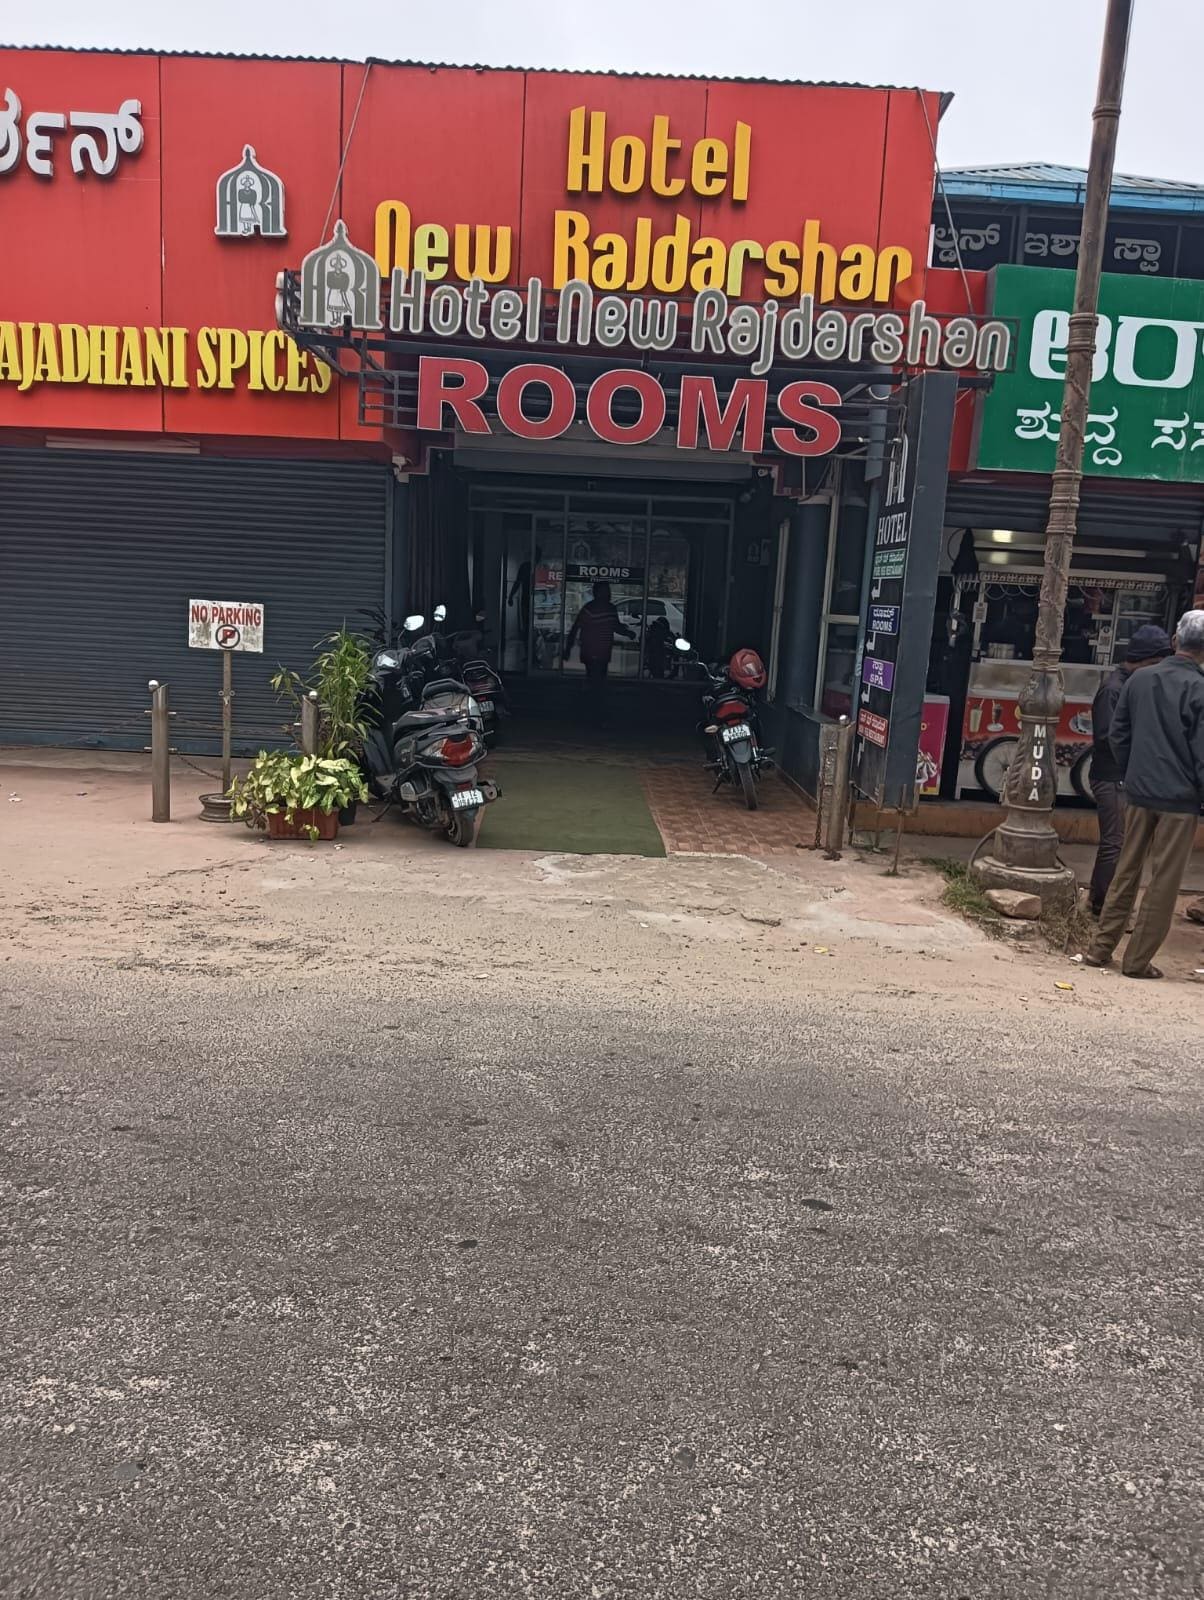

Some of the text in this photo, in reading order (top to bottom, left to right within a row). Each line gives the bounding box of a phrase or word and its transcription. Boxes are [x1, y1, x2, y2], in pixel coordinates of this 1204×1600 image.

[567, 105, 751, 201] Hotel
[375, 200, 511, 282] New
[390, 267, 1011, 375] Hotel New Rajdarshan
[0, 321, 332, 394] AJADHANI SPICES
[416, 355, 842, 457] ROOMS
[876, 511, 908, 545] HOTEL
[579, 565, 630, 578] ROOMS
[191, 605, 261, 627] NO PARKING
[872, 619, 893, 632] ROOMS
[869, 674, 884, 686] SPA
